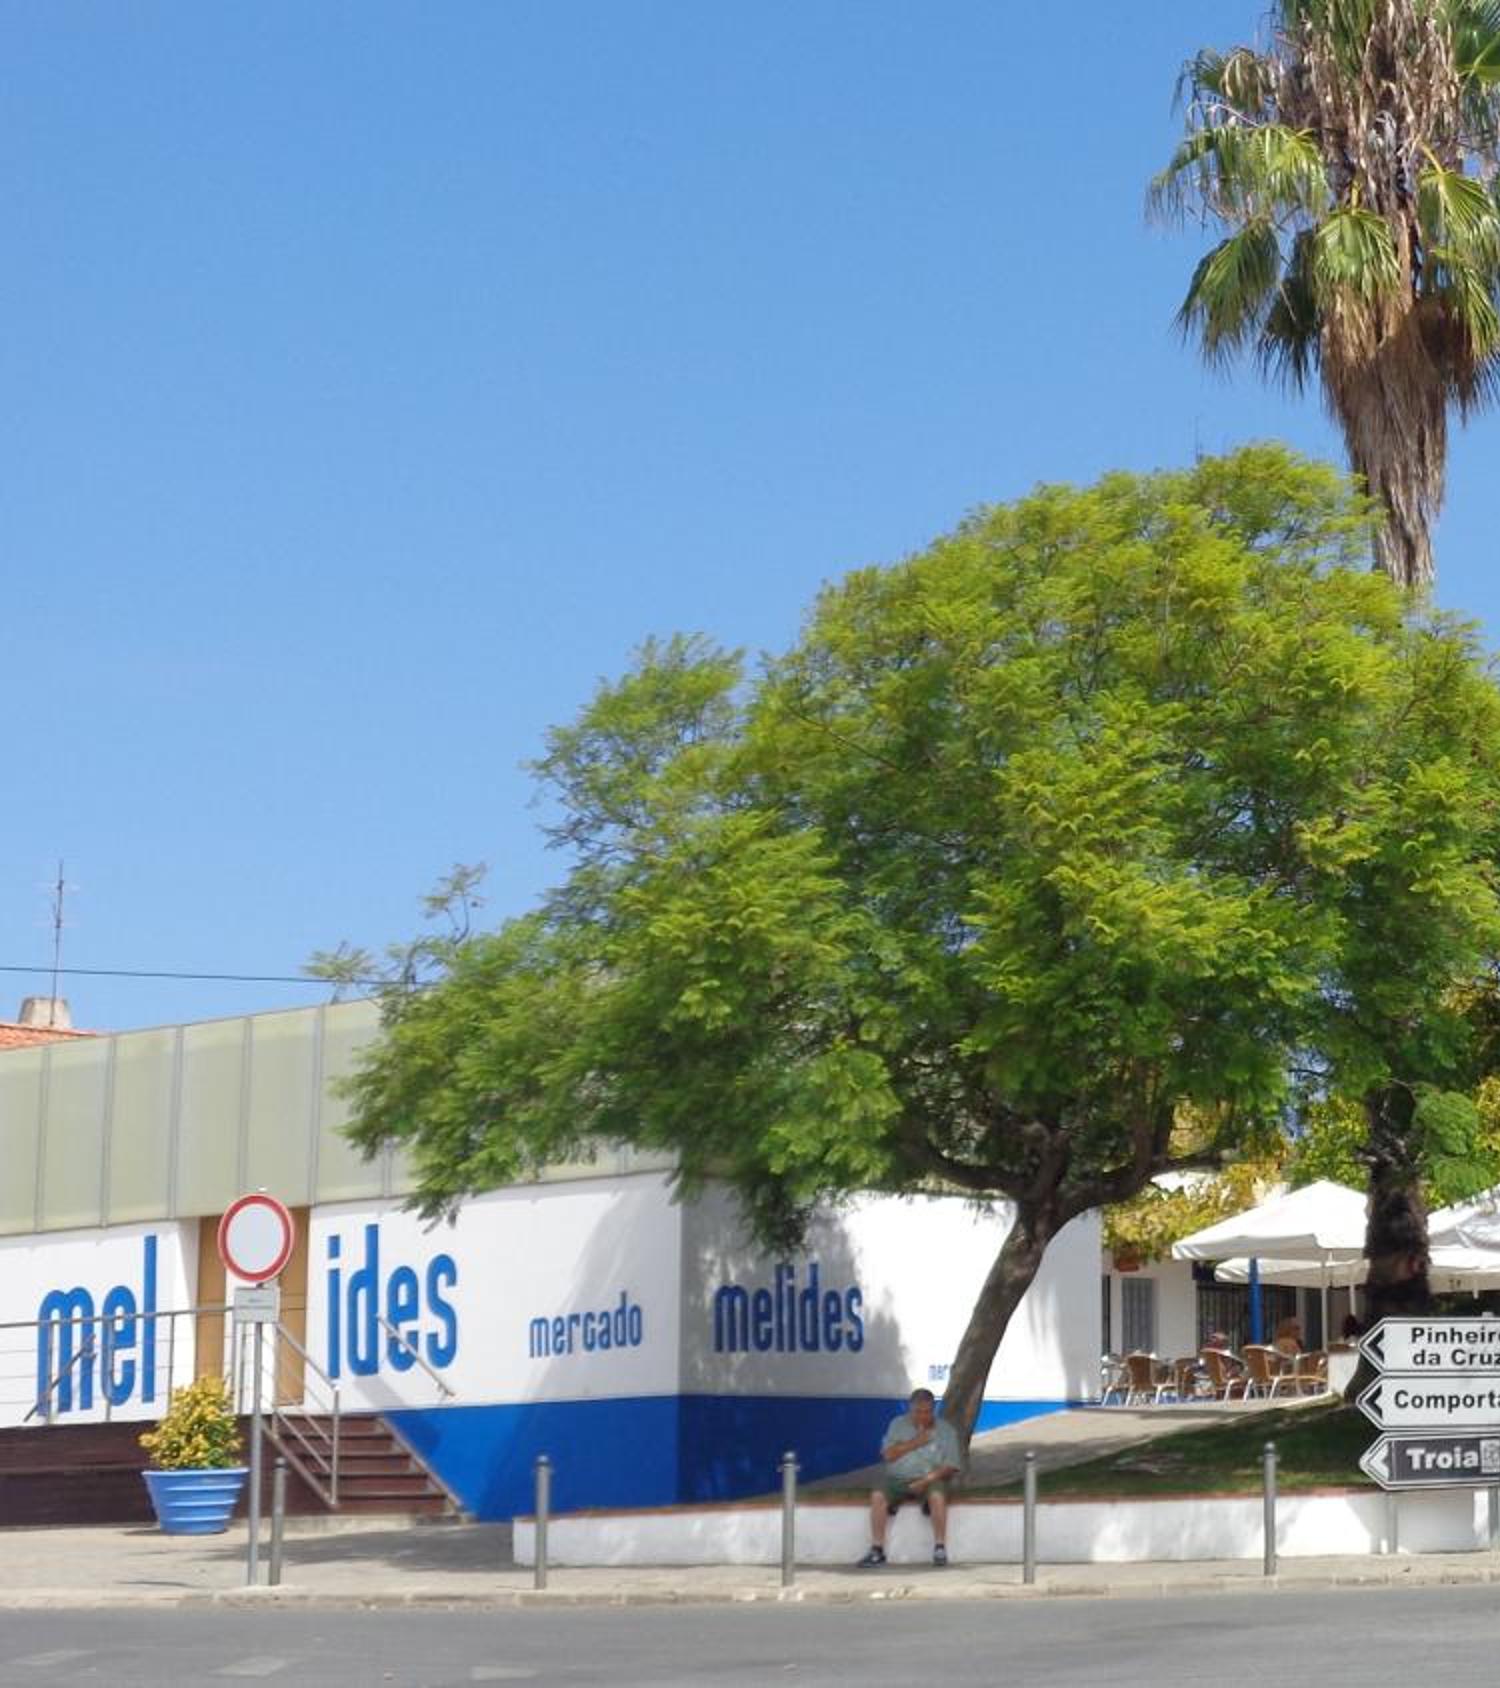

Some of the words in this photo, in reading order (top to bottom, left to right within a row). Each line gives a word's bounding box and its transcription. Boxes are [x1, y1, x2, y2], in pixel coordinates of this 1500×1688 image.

[529, 1290, 643, 1358] mercado
[714, 1262, 865, 1353] melides
[1412, 1350, 1441, 1366] da
[1405, 1445, 1479, 1470] Troia
